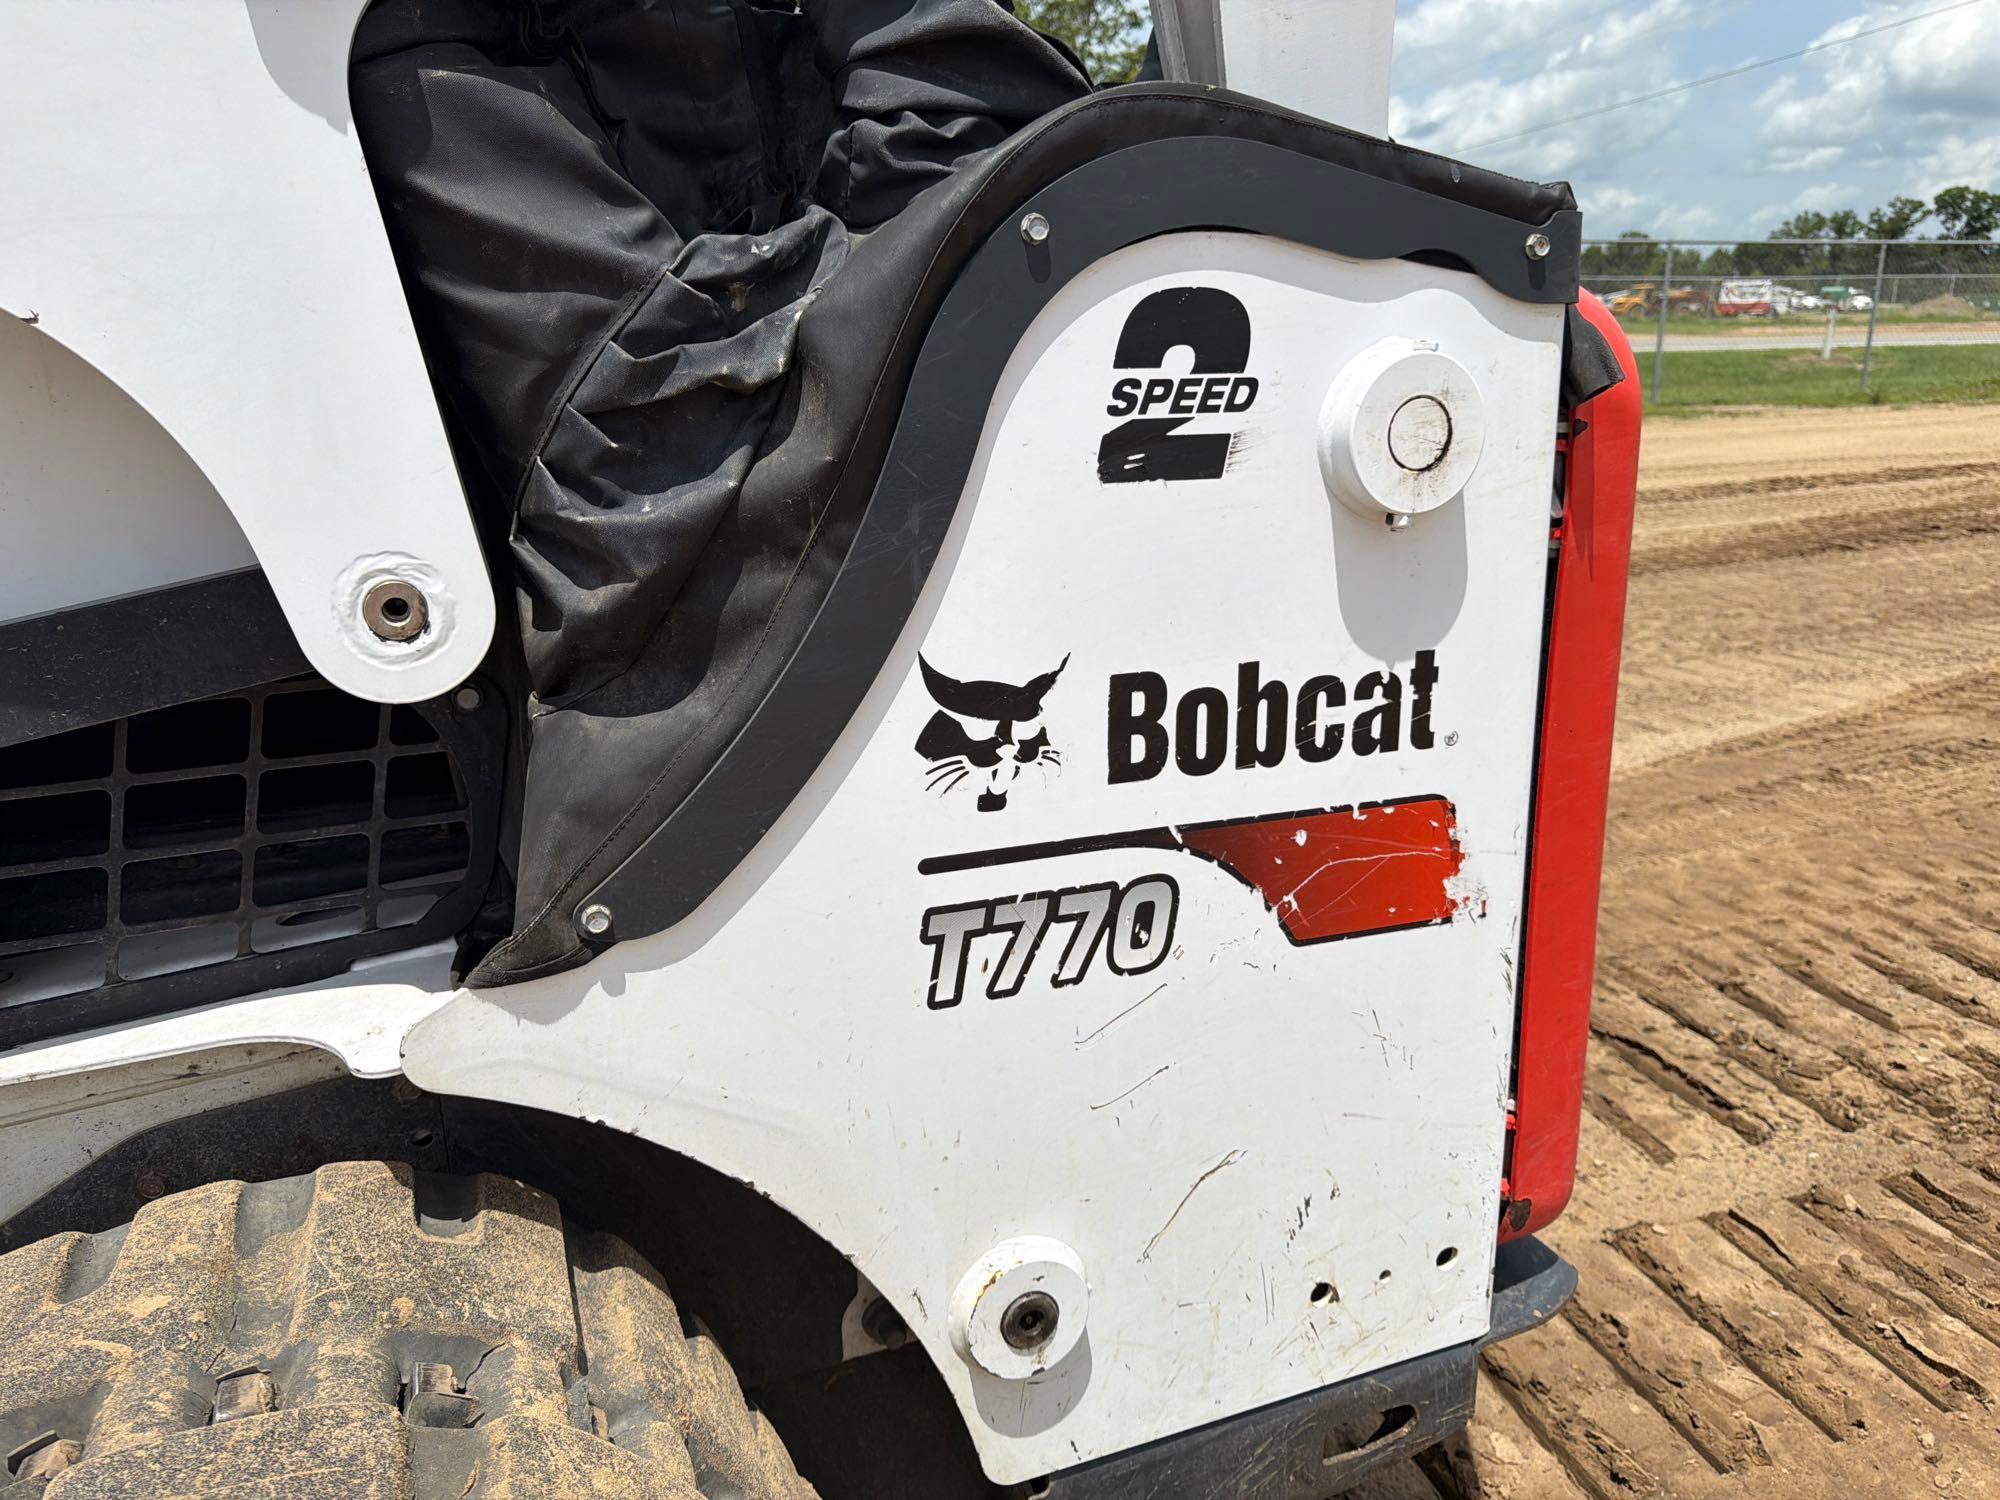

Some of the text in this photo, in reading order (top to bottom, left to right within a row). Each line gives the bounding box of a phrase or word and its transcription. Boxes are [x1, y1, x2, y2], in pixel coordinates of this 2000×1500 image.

[1097, 286, 1251, 484] 2
[1107, 377, 1259, 417] SPEED
[1107, 649, 1439, 785] Bobcat
[919, 873, 1180, 1010] T770
